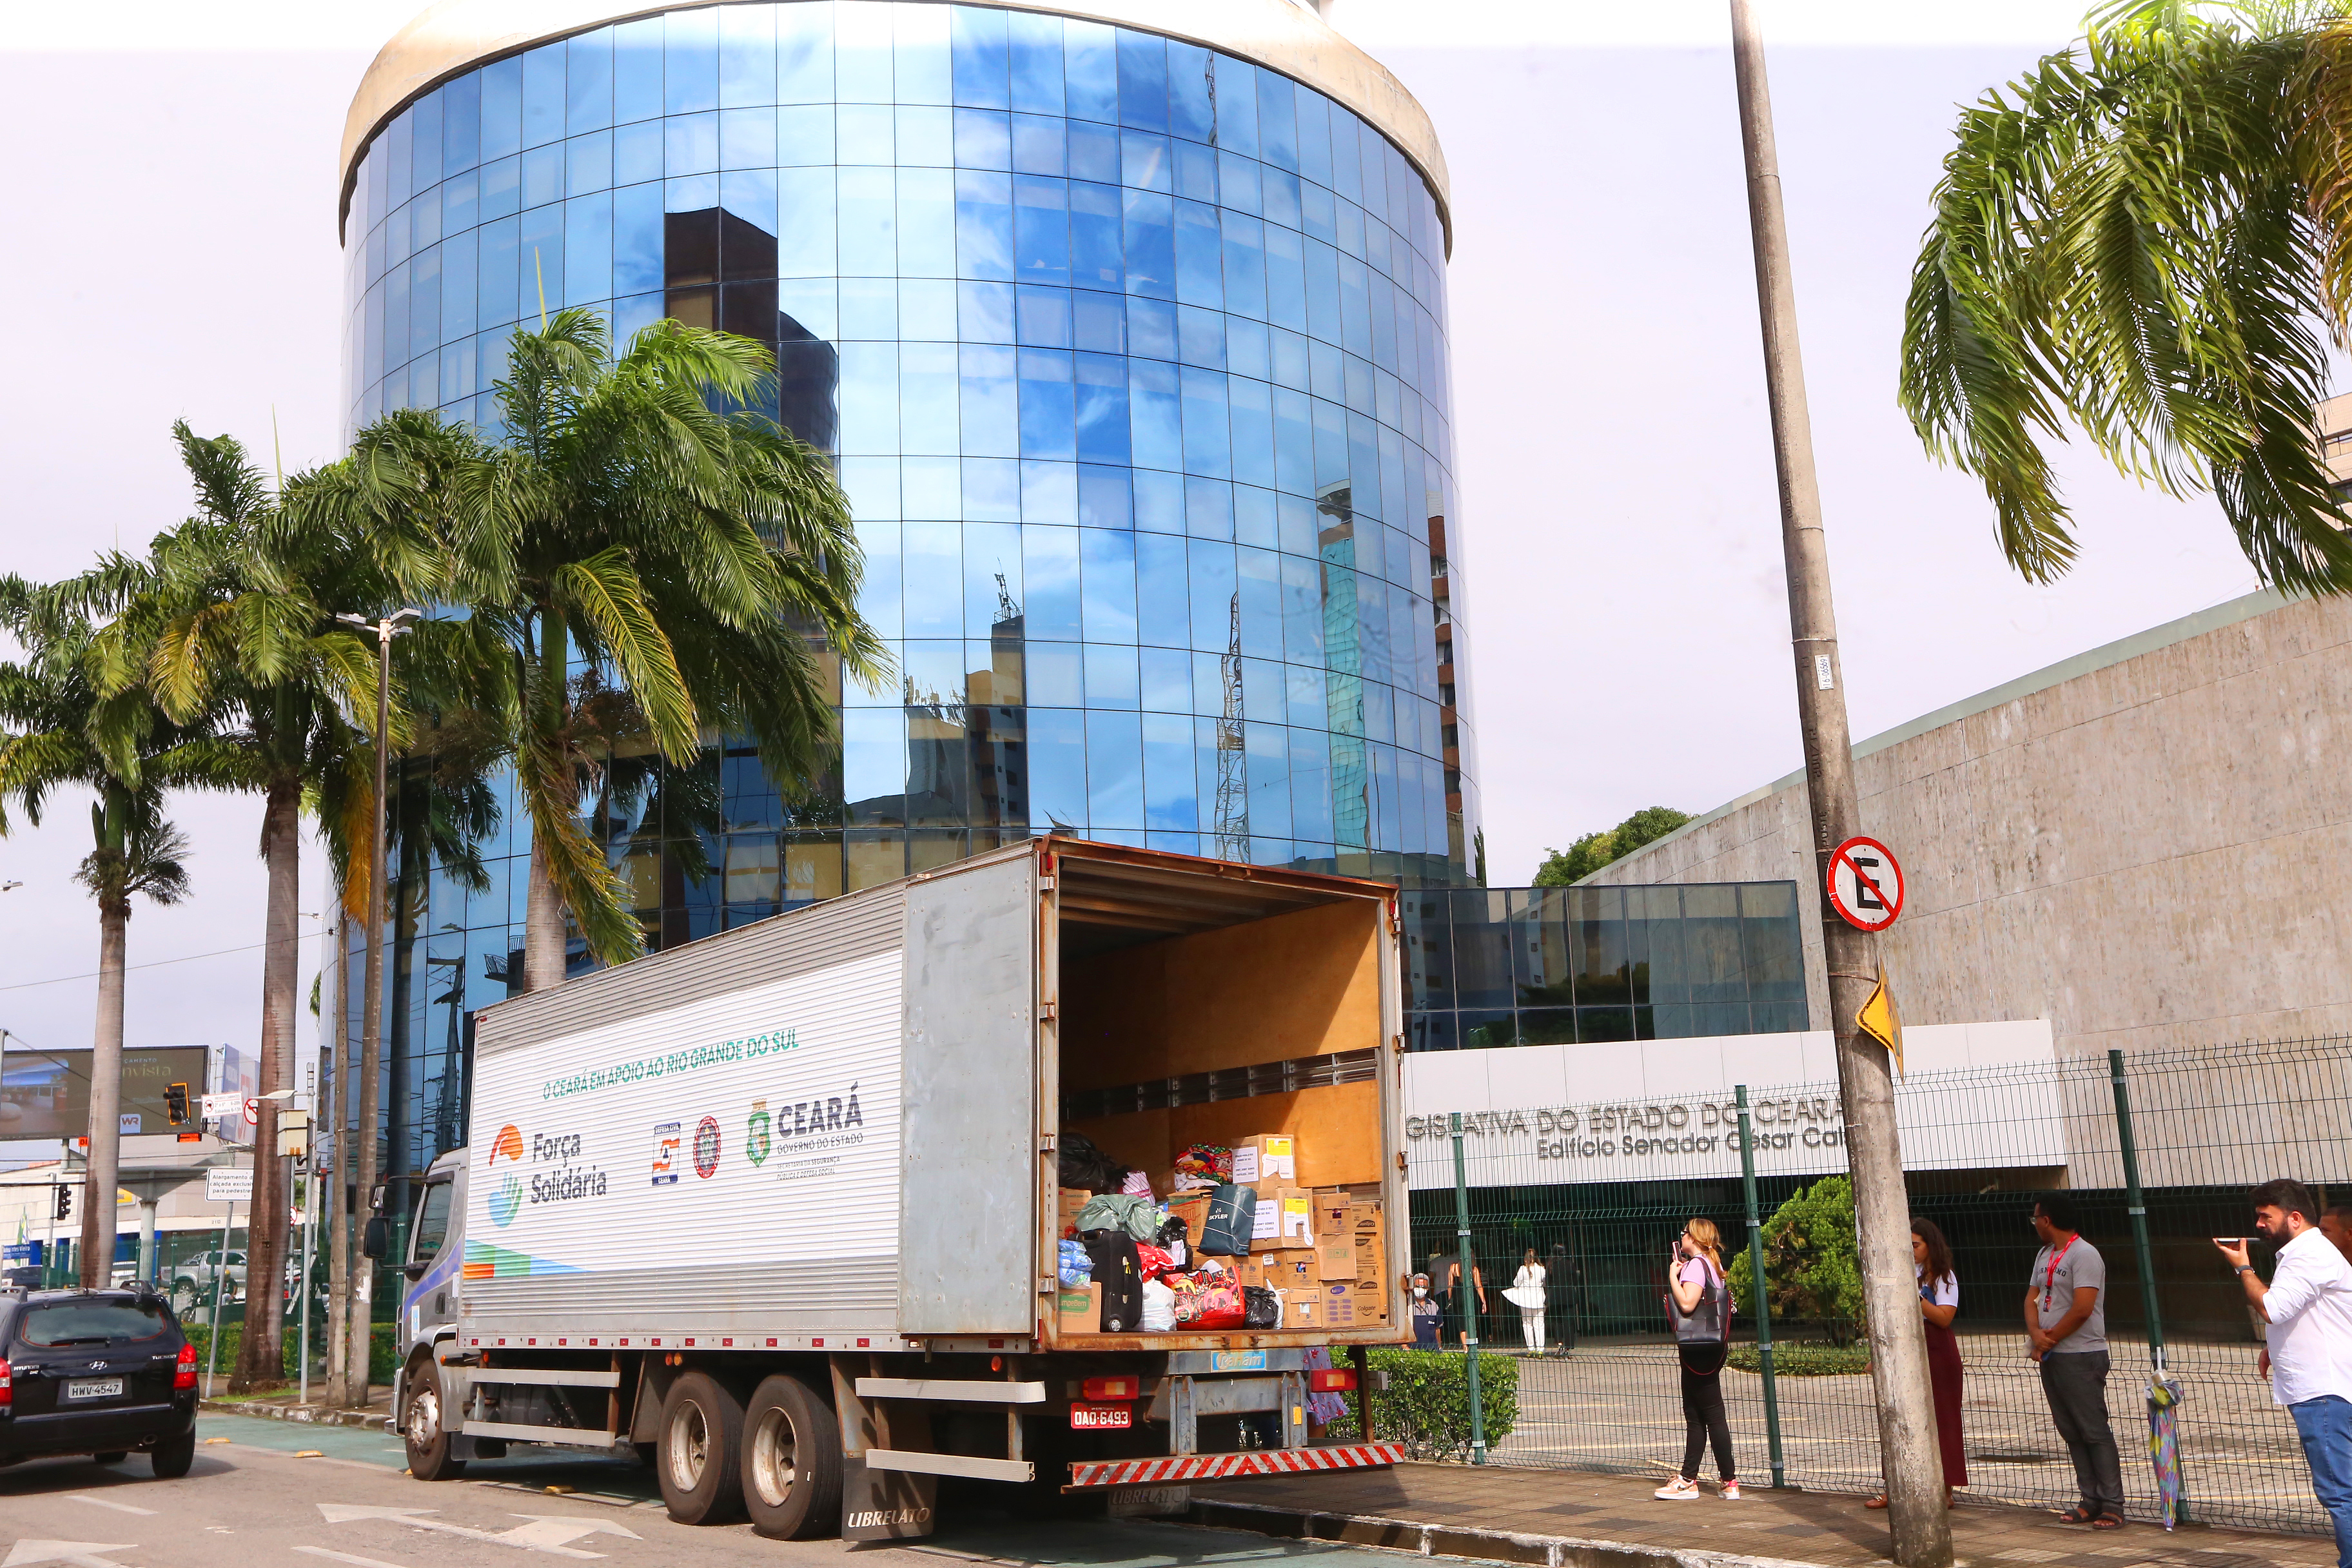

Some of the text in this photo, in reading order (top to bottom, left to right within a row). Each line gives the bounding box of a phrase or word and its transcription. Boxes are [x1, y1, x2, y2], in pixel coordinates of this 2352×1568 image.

[1820, 658, 1830, 686] 16-06569
[1854, 857, 1883, 910] E
[543, 1028, 799, 1100] O CEARÁ EM APOIO AO RIO GRANDE DO SUL
[122, 1117, 139, 1126] WR
[778, 1081, 863, 1139] CEARÁ
[1537, 1108, 1579, 1133] DO
[1589, 1103, 1689, 1130] ESTADO
[655, 1125, 669, 1133] DEFESA
[533, 1133, 581, 1168] Força
[777, 1133, 863, 1155] GOVERNO DO ESTADO
[1538, 1135, 1616, 1159] Edifício
[1623, 1132, 1719, 1155] Senador
[776, 1171, 796, 1181] PÚBLICA
[818, 1168, 836, 1176] SOCIAL
[777, 1161, 803, 1170] SECRETARIA
[811, 1156, 840, 1165] SEGURANÇA
[531, 1164, 606, 1204] Solidária
[1112, 1489, 1184, 1505] LIBRELATO
[847, 1507, 930, 1528] LIBRELATO
